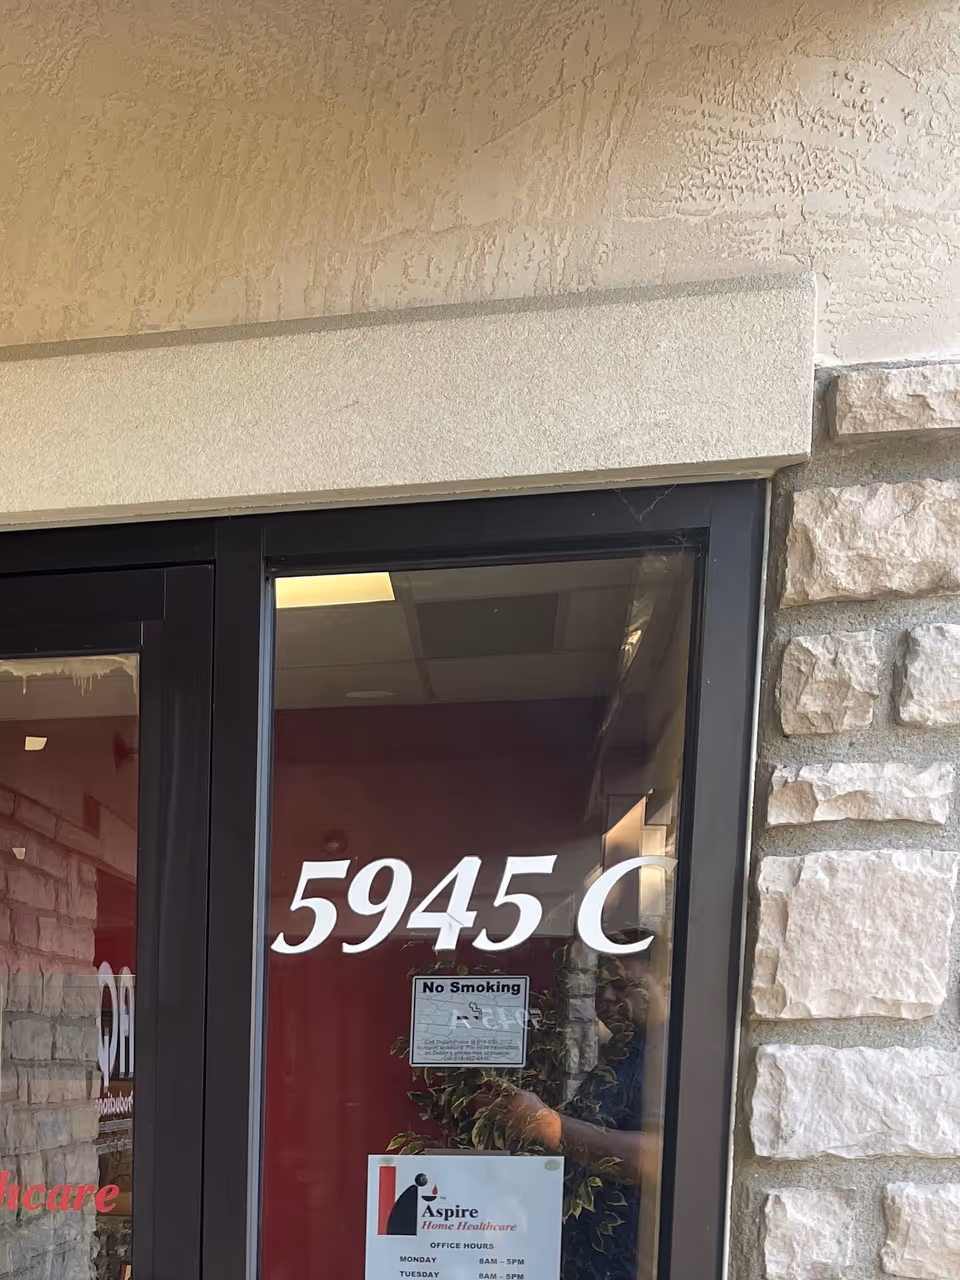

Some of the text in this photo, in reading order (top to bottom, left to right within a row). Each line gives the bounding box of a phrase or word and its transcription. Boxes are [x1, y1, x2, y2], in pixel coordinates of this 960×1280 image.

[271, 855, 678, 956] 5945 C
[422, 981, 521, 995] No Smoking
[421, 1205, 479, 1221] Aspire
[421, 1221, 517, 1232] Home Healthcare
[463, 1242, 495, 1250] HOURS
[399, 1270, 439, 1278] TUESDAY
[478, 1272, 497, 1280] 8AM
